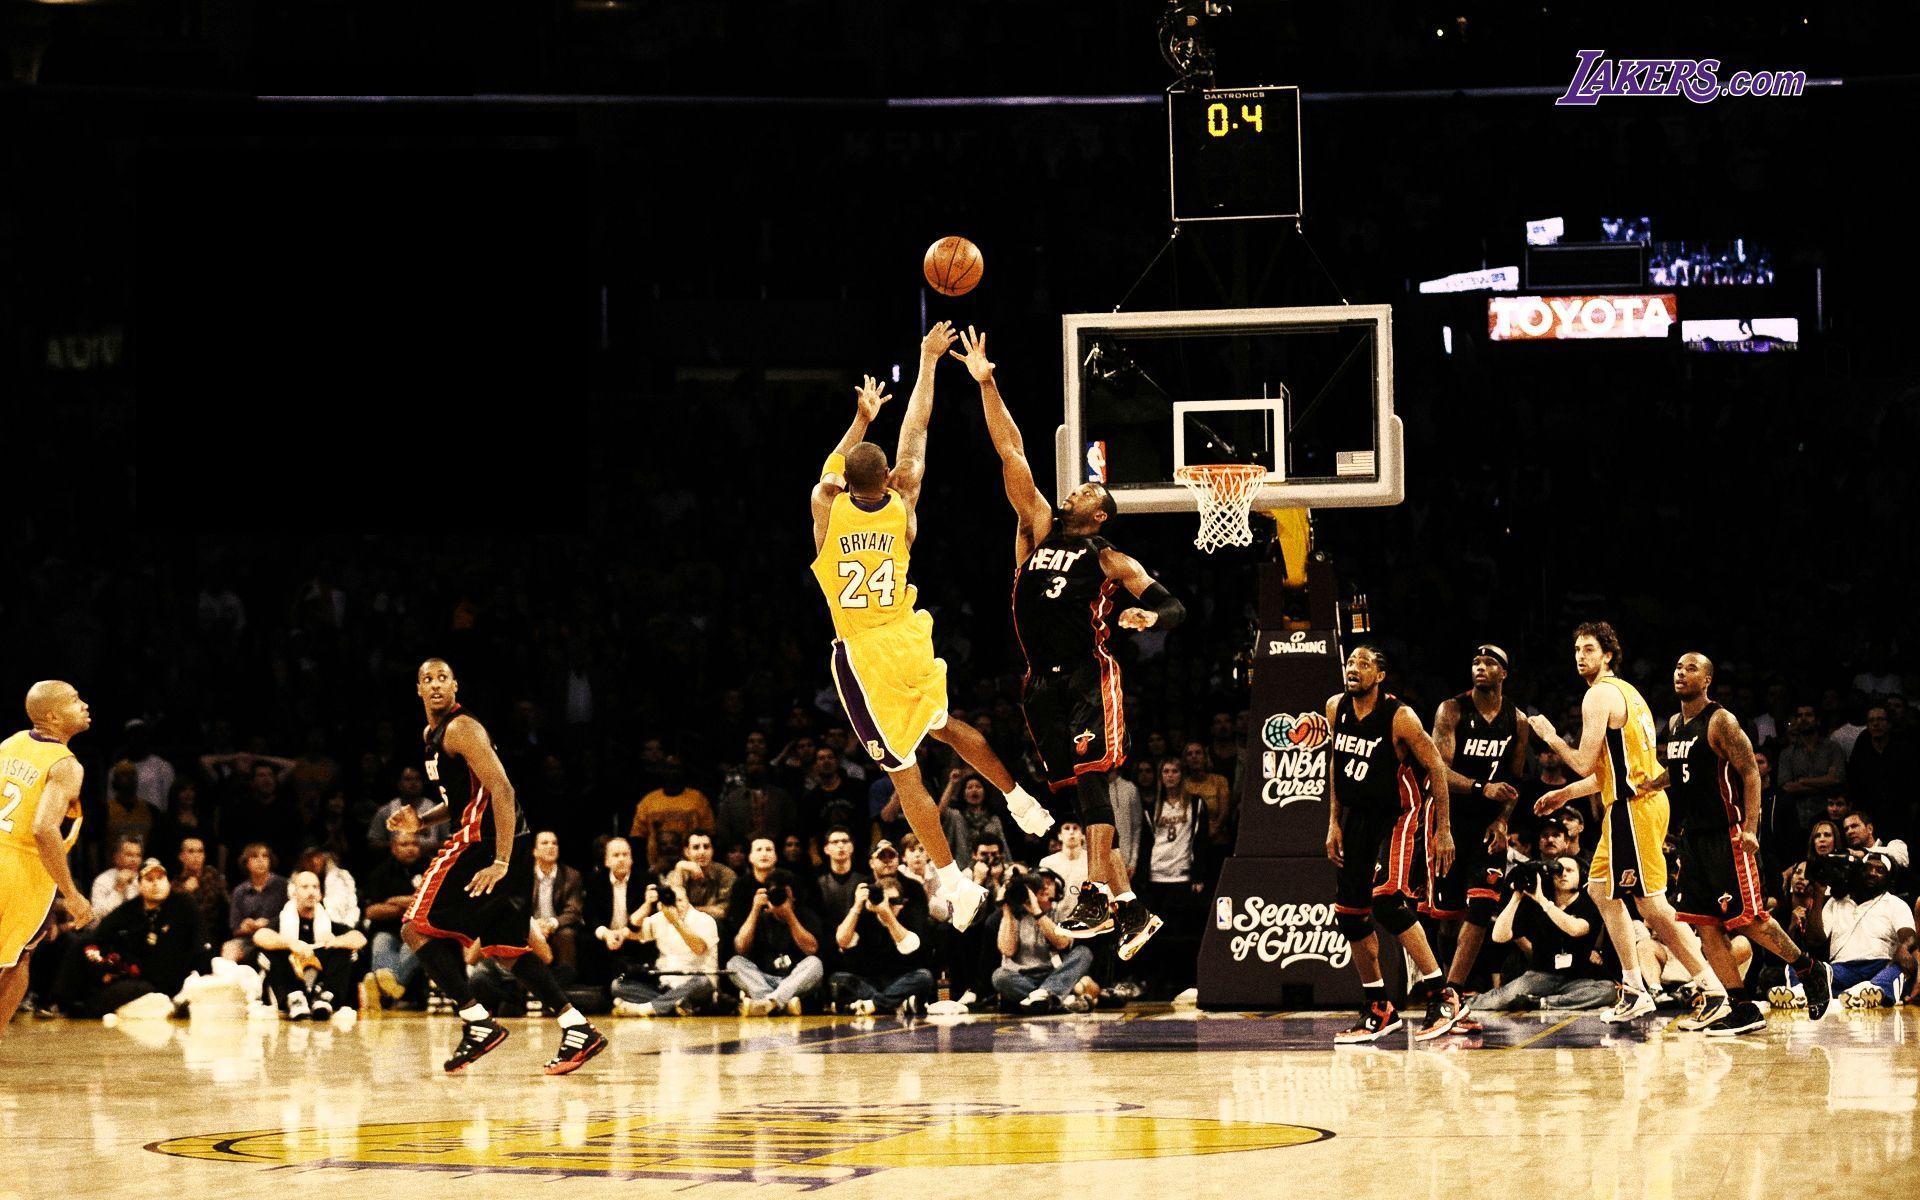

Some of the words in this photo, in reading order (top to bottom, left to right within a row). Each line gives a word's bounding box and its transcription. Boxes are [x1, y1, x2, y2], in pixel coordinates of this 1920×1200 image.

[1204, 92, 1265, 100] DAKTRONICS
[1208, 103, 1263, 137] 0.4
[1489, 298, 1675, 340] TOYOTA
[839, 532, 895, 554] BRYANT
[1028, 548, 1087, 572] HEAT
[838, 558, 896, 609] 24
[1045, 576, 1068, 599] 3
[1269, 640, 1327, 655] SPALDING
[1335, 733, 1383, 758] HEAT
[1463, 735, 1513, 757] HEAT
[1277, 751, 1327, 778] NBA
[1344, 758, 1369, 782] 40
[1682, 763, 1690, 783] 5
[1261, 777, 1326, 805] Cares
[1230, 931, 1260, 961] of
[1257, 925, 1352, 969] Giving
